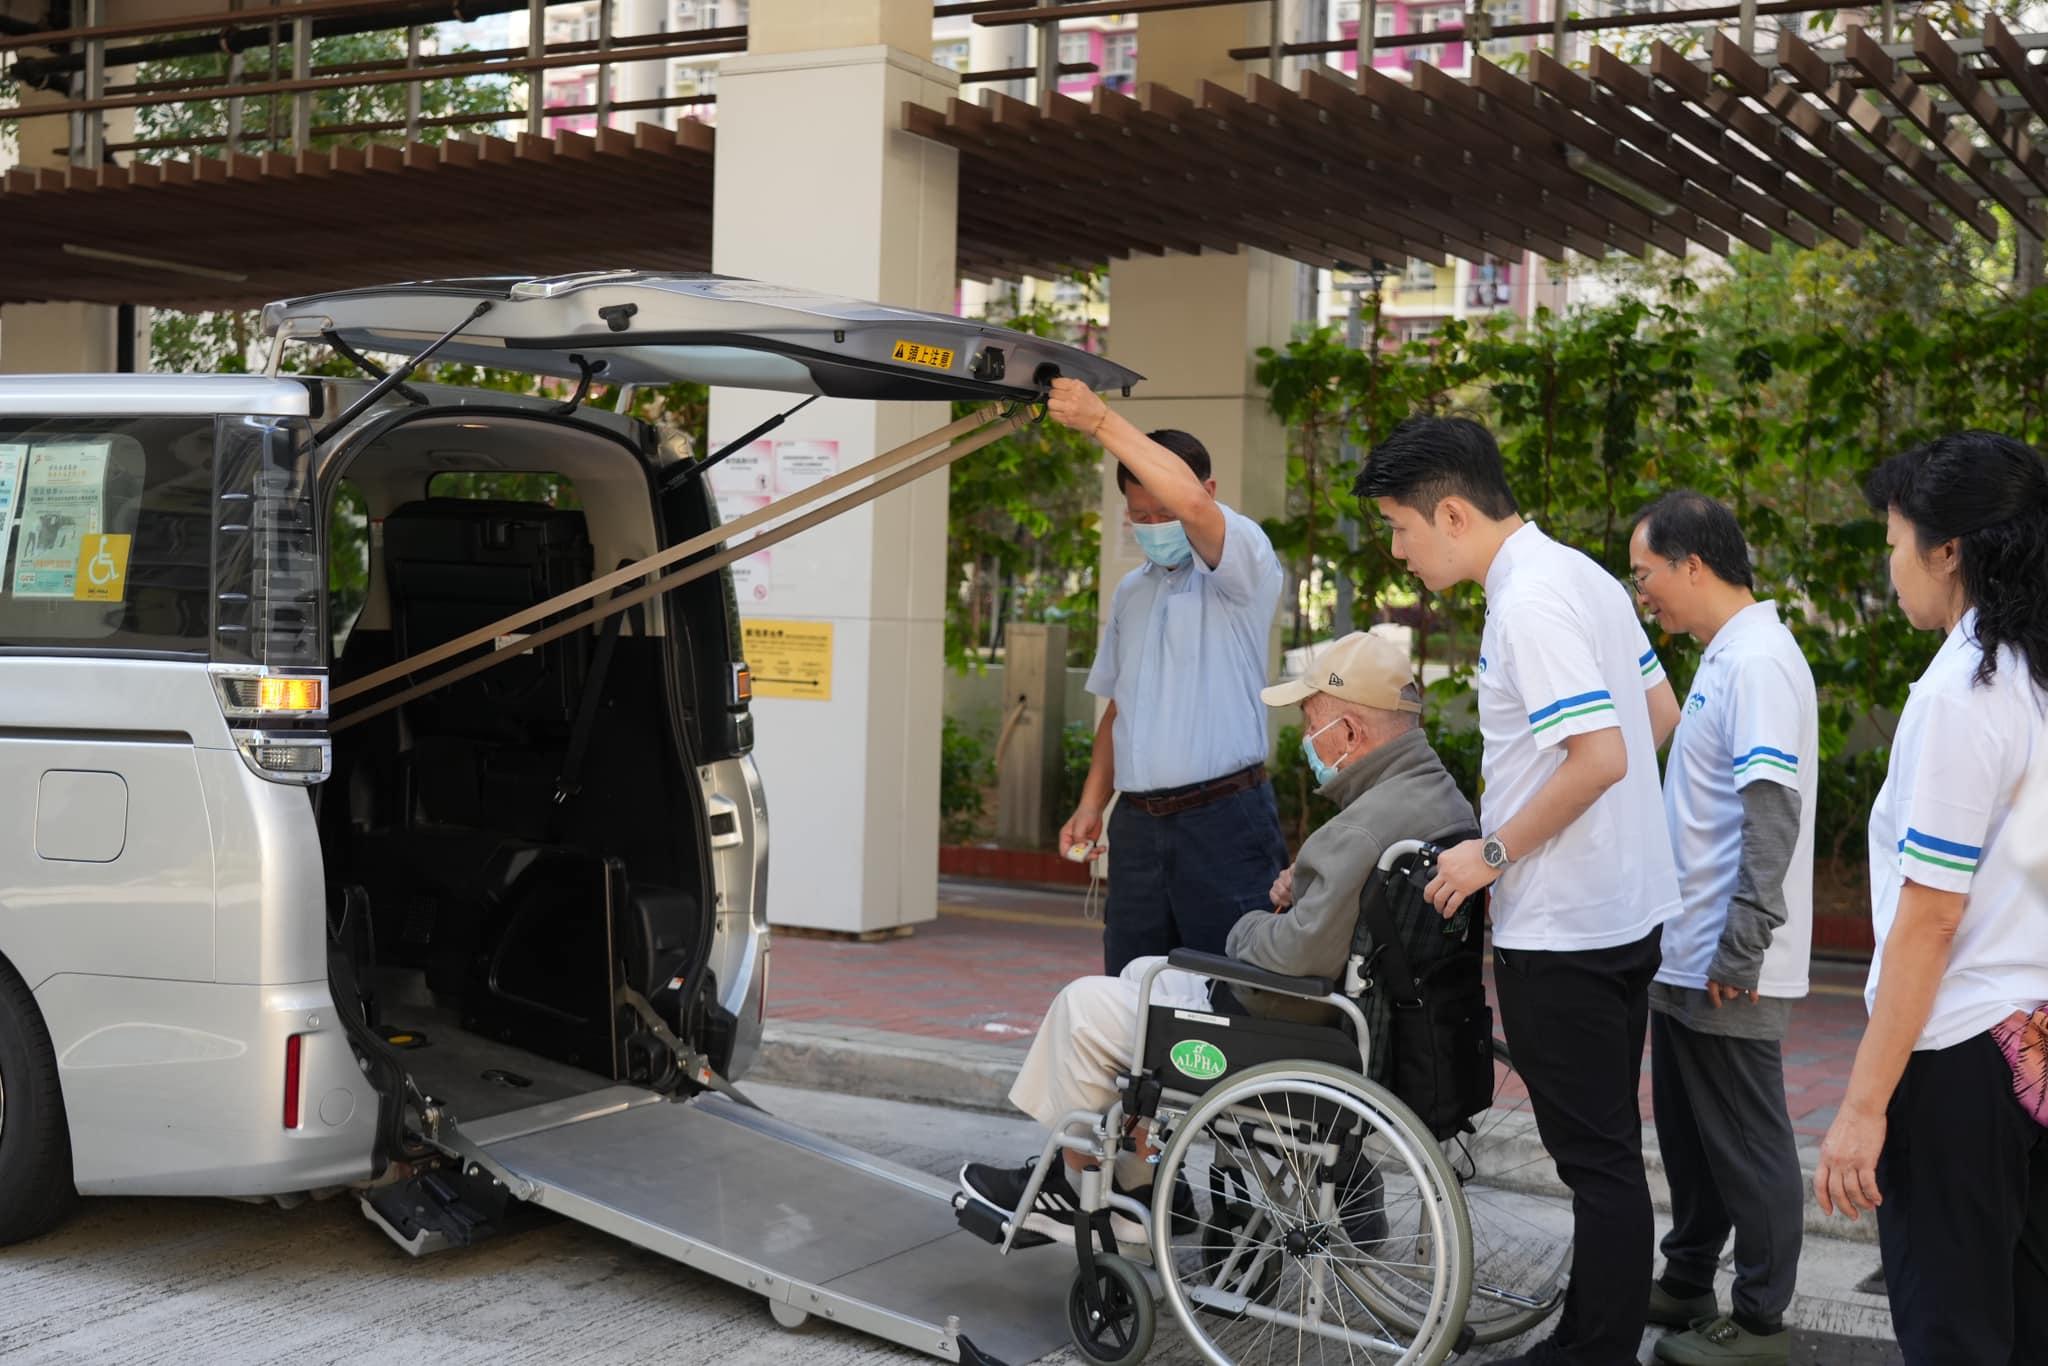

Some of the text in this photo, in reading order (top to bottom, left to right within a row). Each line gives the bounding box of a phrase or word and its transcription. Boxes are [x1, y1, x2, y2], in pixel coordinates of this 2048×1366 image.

[907, 345, 951, 368] 頭上注意
[1176, 1053, 1221, 1073] ALPHA
